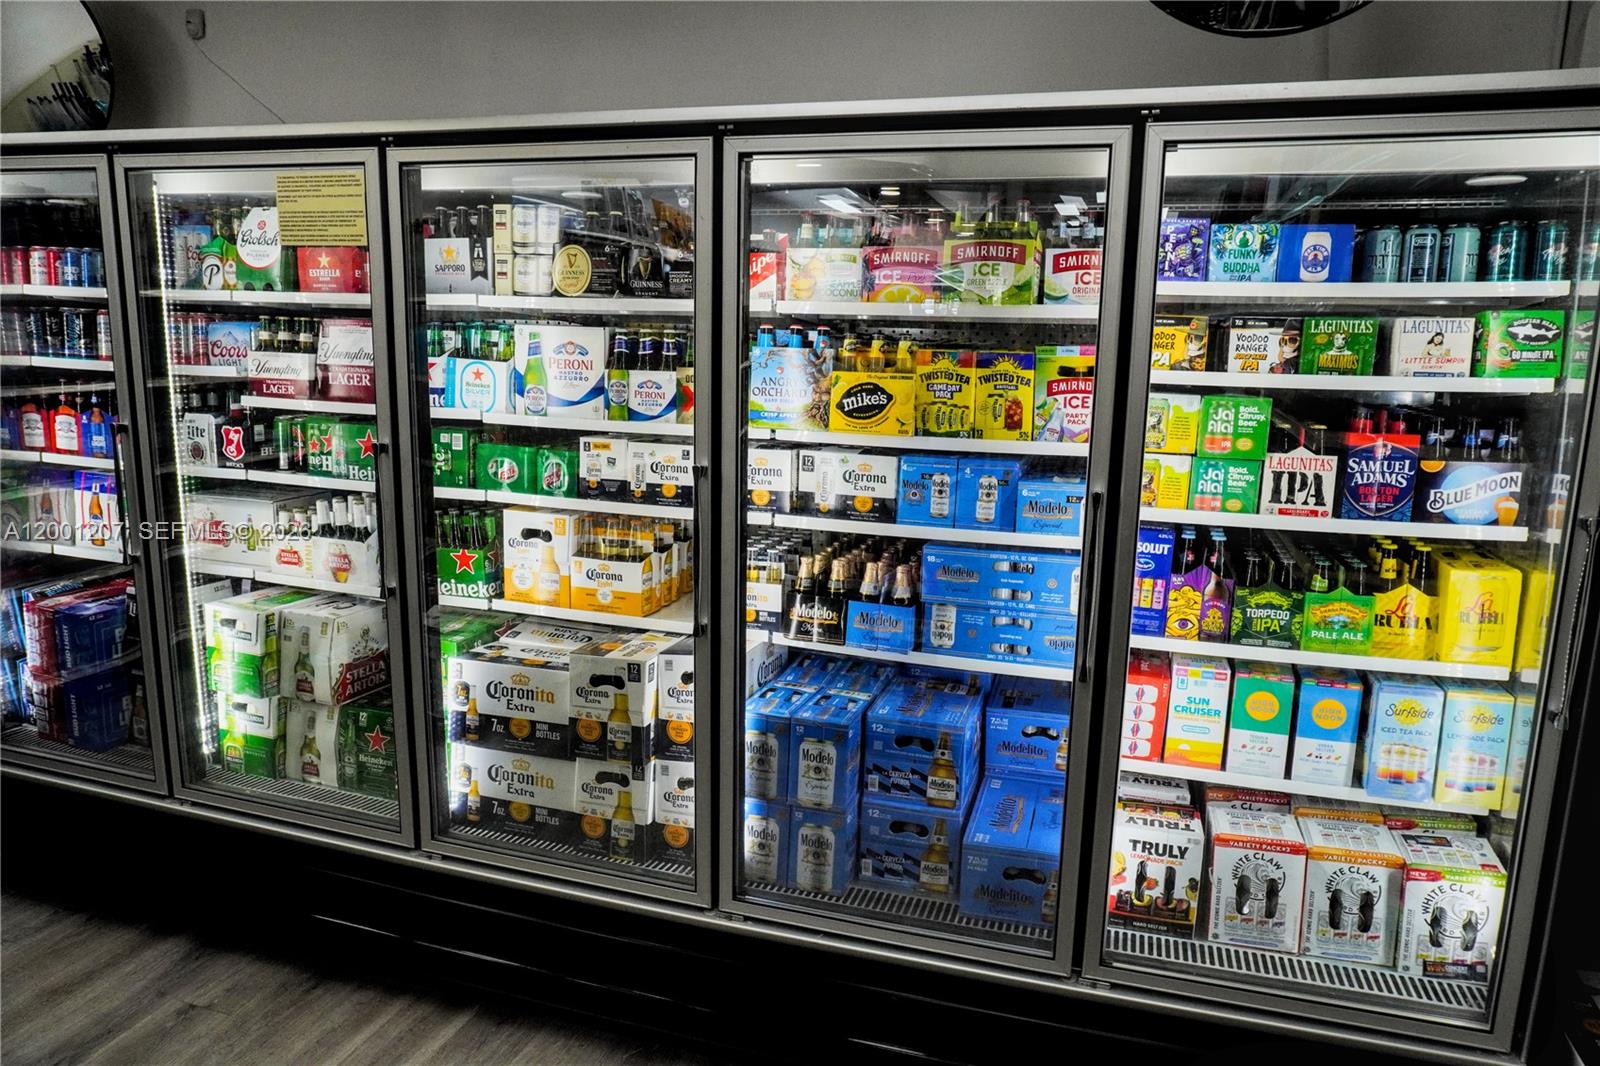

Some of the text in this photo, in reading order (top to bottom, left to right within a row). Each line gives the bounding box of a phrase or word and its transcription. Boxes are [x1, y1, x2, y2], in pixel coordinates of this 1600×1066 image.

[240, 229, 279, 247] Grolsch
[873, 251, 931, 265] SMIRNOFF
[956, 246, 1020, 260] SMIRNOFF
[1227, 249, 1258, 260] FUNKY
[308, 269, 341, 277] ESTRELLA
[434, 264, 466, 273] SAPPORO
[973, 262, 1001, 276] ICE
[1222, 262, 1261, 274] BUDDHA
[875, 271, 902, 284] ICE
[966, 277, 986, 286] GREEN
[1074, 271, 1101, 285] ICE
[1236, 274, 1252, 282] IPA
[629, 280, 663, 289] GUINNESS
[1310, 319, 1374, 334] LAGUNITAS
[1401, 319, 1471, 335] LAGUNITAS
[1541, 318, 1558, 330] HEAD
[1236, 332, 1269, 344] VOODOO
[209, 340, 249, 358] Coors
[318, 342, 375, 364] Yuengling
[1235, 342, 1269, 353] RANGER
[1404, 356, 1466, 365] LITTLE SUMPIN
[1541, 350, 1554, 360] IPA
[218, 358, 243, 367] LIGHT
[250, 358, 302, 377] Yuengling
[548, 357, 593, 371] PERONI
[1239, 360, 1260, 371] IPA
[1317, 354, 1359, 370] MAXIMUS
[328, 373, 371, 386] LAGER
[919, 370, 954, 383] TWISTED
[954, 373, 971, 386] TEA
[977, 372, 1032, 388] TWISTED TEA
[262, 384, 295, 394] LAGER
[752, 386, 807, 398] ORCHARD
[947, 384, 960, 392] DAY
[634, 391, 666, 400] PERONI
[842, 391, 888, 411] mike's
[1063, 396, 1090, 409] ICE
[1065, 412, 1089, 420] PARTY
[1212, 407, 1236, 421] Jai
[1239, 405, 1261, 414] Bold.
[1237, 418, 1259, 427] Beer.
[1238, 413, 1267, 422] Citrusy.
[187, 425, 207, 441] Lite
[976, 429, 984, 438] 12
[1206, 420, 1235, 434] Alai
[1018, 431, 1029, 439] 5%
[650, 461, 689, 474] Corona
[803, 456, 813, 466] 12
[1268, 455, 1334, 472] LAGUNITAS
[1347, 457, 1416, 476] SAMUEL
[659, 473, 680, 481] Extra
[842, 470, 887, 484] Corona
[1202, 467, 1226, 481] Jai
[1228, 466, 1249, 475] Bold.
[750, 476, 773, 486] Extra
[1226, 479, 1248, 488] Beer.
[1227, 473, 1256, 483] Citrusy.
[1350, 472, 1409, 489] ADAMS
[853, 483, 876, 492] Extra
[902, 479, 929, 491] Modelo
[1197, 480, 1224, 495] Alai
[1268, 470, 1328, 507] IPA
[1358, 486, 1400, 496] BOSTON
[1022, 488, 1029, 497] 6
[1360, 494, 1394, 503] LAGER
[1427, 474, 1520, 513] BLUE MOON
[1028, 500, 1068, 515] Modelo
[508, 537, 539, 549] Corona
[585, 567, 623, 582] Corona
[941, 564, 975, 579] Modelo
[796, 604, 833, 620] Modelo
[1246, 608, 1291, 621] TORPEDO
[859, 611, 899, 628] Modelo
[1257, 619, 1281, 633] IPA
[1311, 630, 1364, 641] PALE ALE
[345, 660, 386, 684] STELLA
[629, 665, 639, 673] 12
[757, 653, 783, 688] Corona
[345, 672, 387, 697] ARTOIS
[486, 680, 555, 704] Coronita
[575, 686, 609, 699] Corona
[506, 699, 535, 713] Extra
[1186, 695, 1211, 706] SUN
[1252, 699, 1274, 708] HIGH
[1173, 704, 1222, 717] CRUISER
[1249, 705, 1276, 714] NOON
[1319, 707, 1342, 715] HIGH
[1384, 703, 1435, 720] Surfside
[1315, 713, 1343, 722] NOON
[535, 723, 549, 731] MINI
[871, 723, 883, 732] 12
[1380, 727, 1433, 737] ICED TEA PACK
[535, 730, 561, 741] BOTTLES
[1001, 740, 1044, 756] Modelito
[358, 754, 393, 767] Heineken
[801, 748, 834, 765] Modelo
[487, 763, 554, 790] Coronita
[930, 778, 954, 788] Modelo
[507, 783, 535, 798] Extra
[581, 782, 613, 795] Corona
[588, 793, 606, 801] Extra
[535, 807, 548, 815] MINI
[867, 809, 879, 818] 12
[535, 815, 560, 826] BOTTLES
[1124, 815, 1196, 832] TRULY
[801, 833, 833, 849] Modelo
[1229, 840, 1260, 850] VARIETY
[1128, 838, 1190, 860] TRULY
[1129, 852, 1165, 865] LEMONADE
[1322, 854, 1356, 864] VARIETY
[922, 864, 948, 874] Modelo
[1231, 852, 1284, 881] WHITE CLAW
[1325, 865, 1379, 894] WHITE CLAW
[1409, 870, 1428, 878] NEW
[1421, 883, 1447, 916] WHITE
